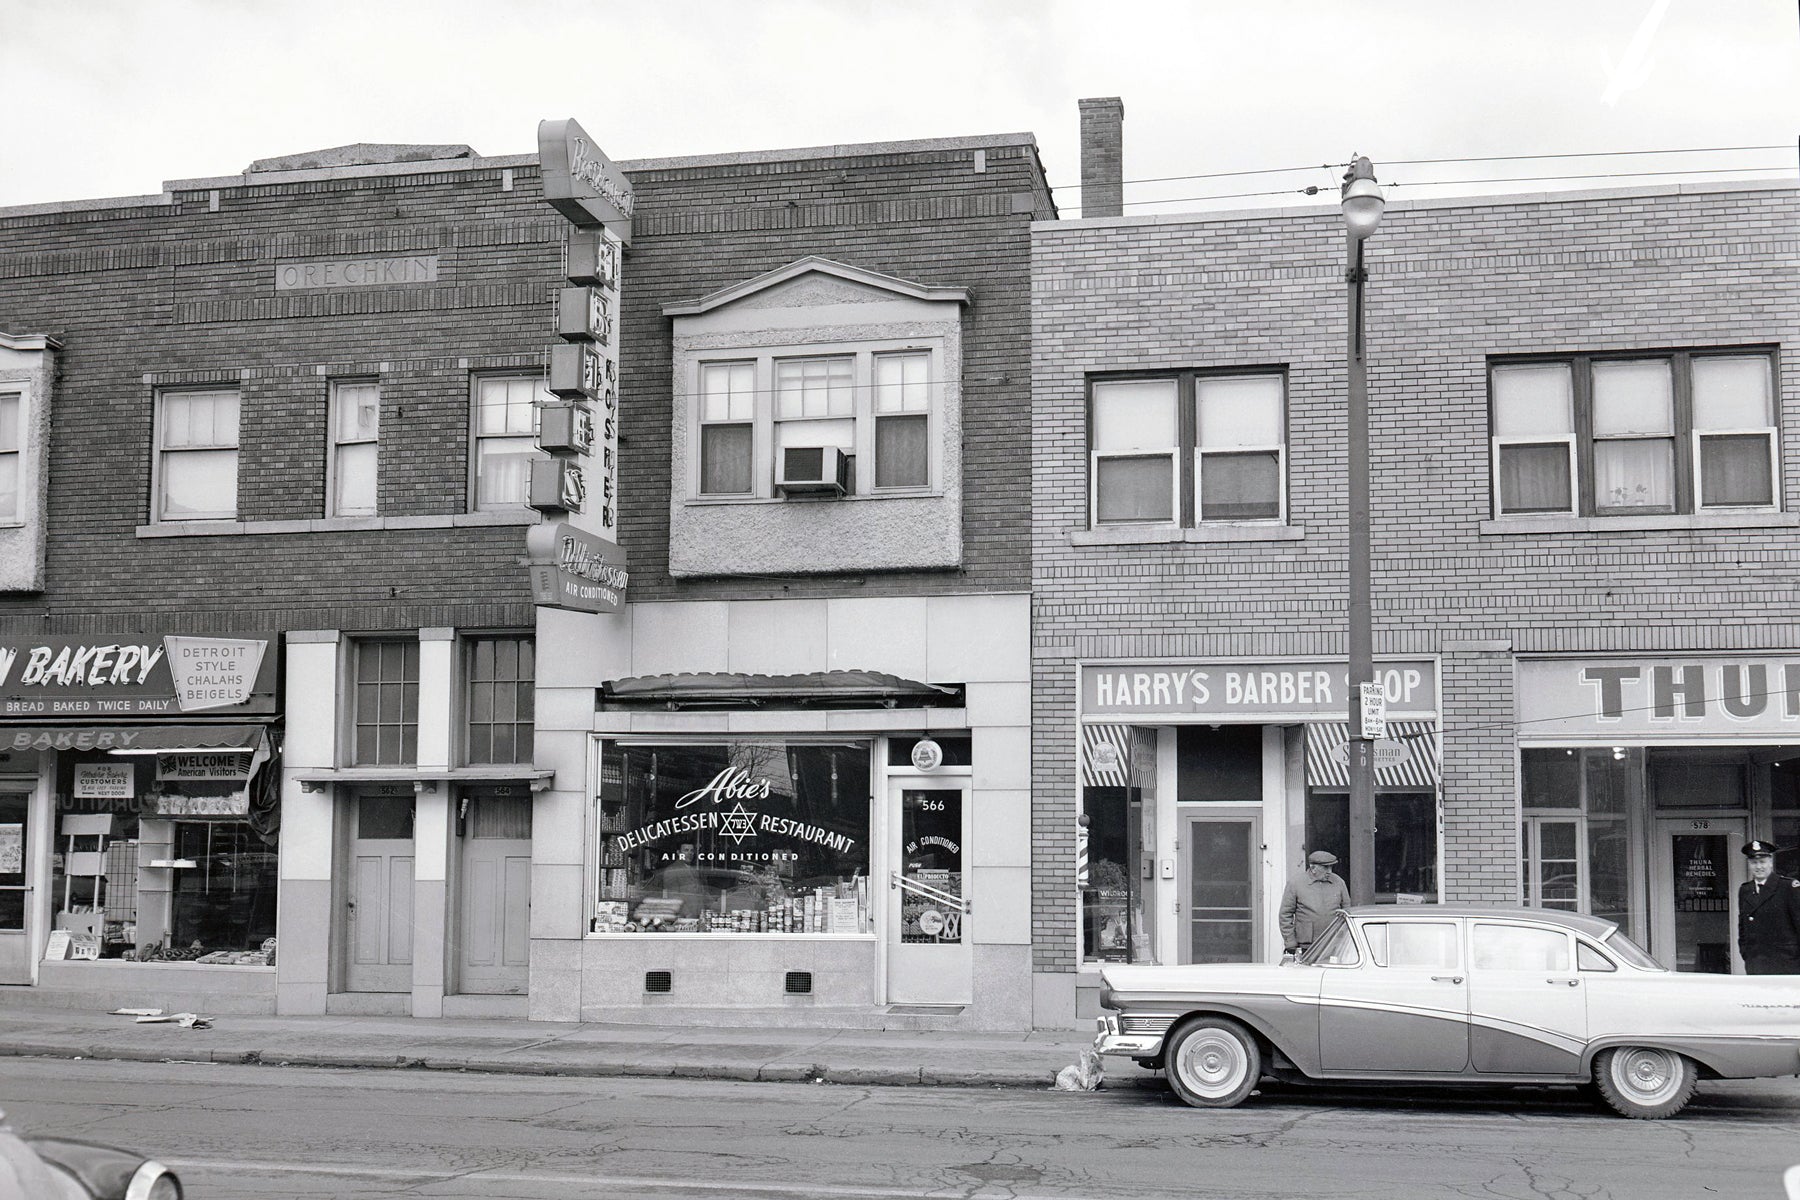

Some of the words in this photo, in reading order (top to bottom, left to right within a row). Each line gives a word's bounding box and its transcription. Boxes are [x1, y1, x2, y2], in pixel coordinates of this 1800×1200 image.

[283, 258, 430, 287] ORECHKIN
[565, 581, 578, 597] AIR
[580, 585, 618, 606] CONDITIONED
[183, 647, 246, 658] DETROIT
[21, 645, 165, 686] BAKERY
[195, 661, 236, 672] STYLE
[187, 675, 243, 686] CHALAHS
[1097, 669, 1210, 706] HARRY'S
[1225, 669, 1332, 704] BARBER
[1344, 669, 1421, 703] OP
[1363, 685, 1383, 696] PARKING
[187, 689, 242, 700] BEIGELS
[6, 701, 45, 712] BREAD
[53, 700, 91, 711] BAKED
[97, 700, 131, 711] TWICE
[1364, 697, 1369, 706] 2
[1369, 698, 1383, 706] HOUR
[1367, 708, 1380, 716] LIMIT
[13, 731, 140, 746] BAKERY
[1342, 744, 1401, 761] Ssman
[178, 755, 235, 767] WELCOME
[177, 768, 206, 777] American
[209, 767, 237, 777] Visitors
[675, 766, 771, 809] Abie's
[922, 799, 945, 811] 566
[1693, 821, 1709, 830] 578
[617, 811, 719, 852] DELICATESSEN
[760, 814, 855, 854] RESTAURANT
[906, 841, 919, 854] AIR
[920, 835, 960, 855] CONDITIONED
[661, 853, 687, 861] AIR
[698, 852, 799, 861] CONDITIONED
